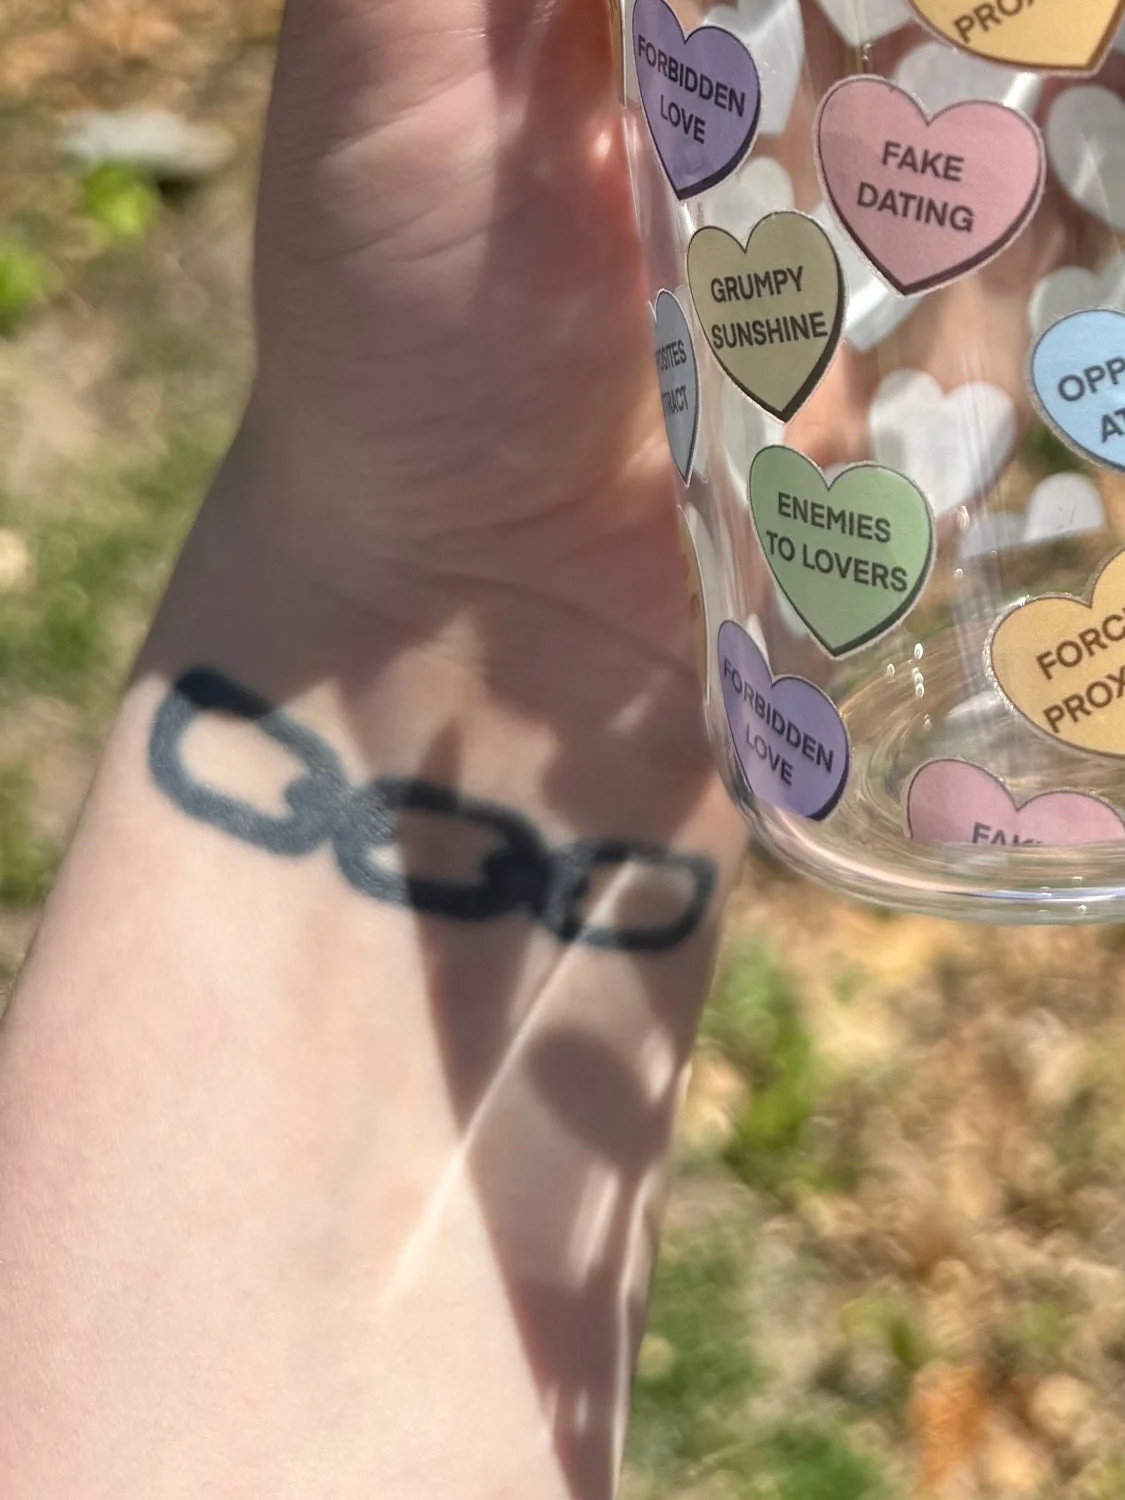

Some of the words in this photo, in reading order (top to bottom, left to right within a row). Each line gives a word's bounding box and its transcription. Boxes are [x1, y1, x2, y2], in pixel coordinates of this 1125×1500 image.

[638, 35, 745, 117] FORBIDDEN
[659, 95, 705, 144] LOVE
[881, 140, 964, 182] FAKE
[857, 182, 975, 232] DATING
[711, 266, 804, 302] GRUMPY
[711, 312, 828, 349] SUNSHINE
[778, 492, 891, 543] ENEMIES
[766, 530, 795, 561] TO
[802, 543, 908, 593] LOVERS
[723, 656, 834, 773] FORBIDDEN
[746, 727, 793, 786] LOVE
